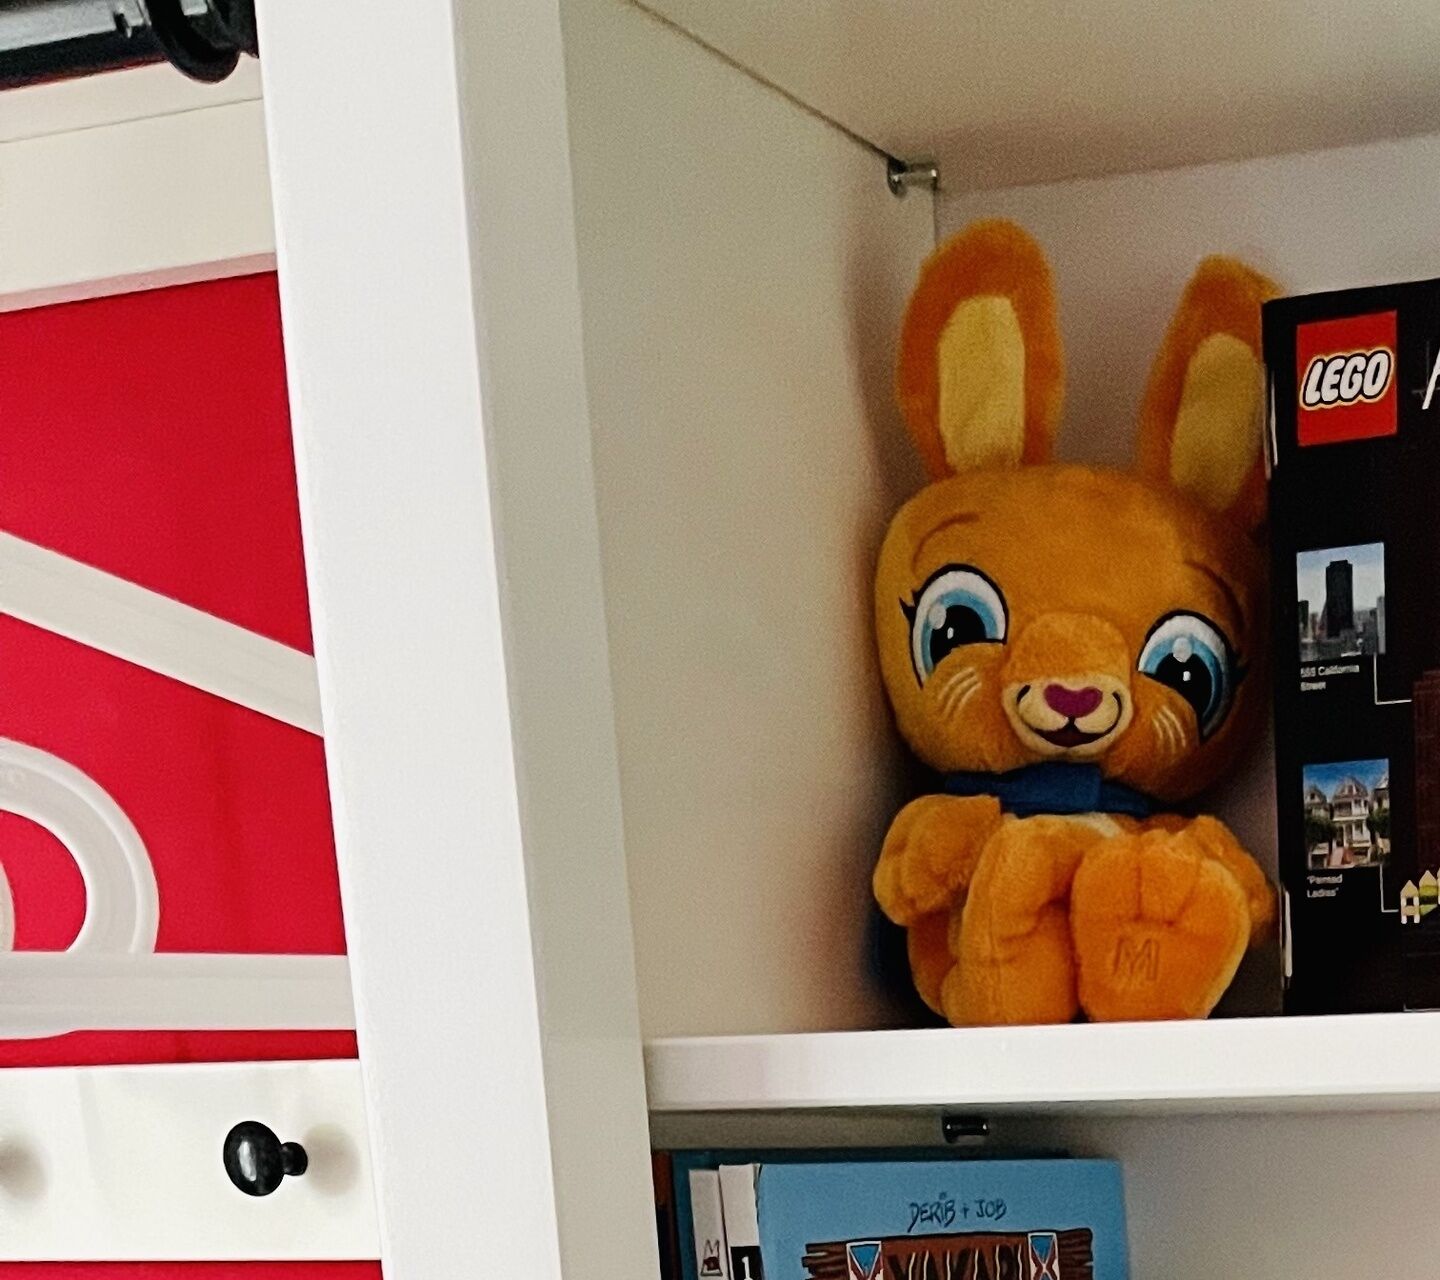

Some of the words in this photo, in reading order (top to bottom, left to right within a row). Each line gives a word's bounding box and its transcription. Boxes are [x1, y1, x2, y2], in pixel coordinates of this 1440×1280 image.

[1302, 351, 1392, 408] LEGO
[1318, 664, 1360, 676] California
[975, 1197, 1008, 1221] JOB
